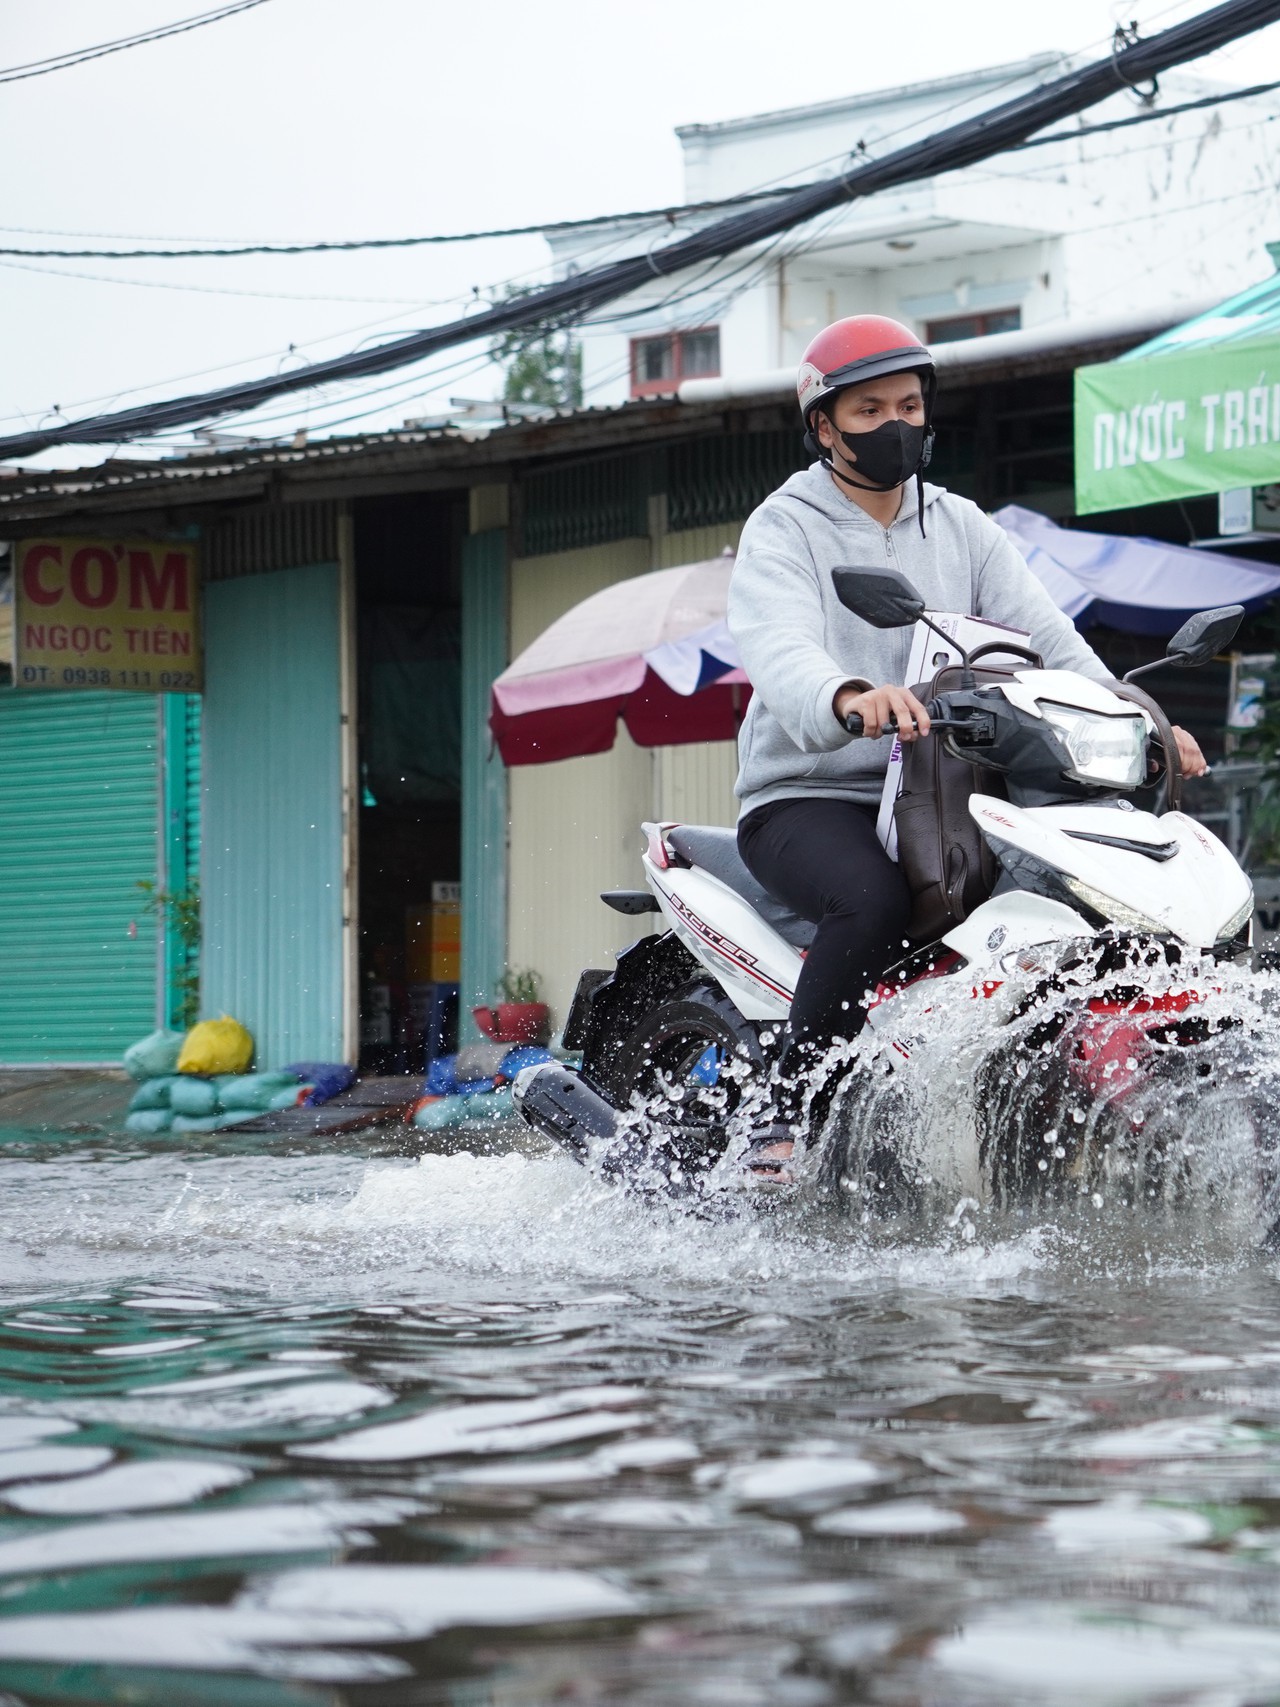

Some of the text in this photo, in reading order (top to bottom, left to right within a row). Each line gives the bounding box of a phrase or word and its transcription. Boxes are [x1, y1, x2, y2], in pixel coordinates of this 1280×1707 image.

[1094, 391, 1186, 472] NƯỚC
[22, 543, 190, 613] CƠM
[25, 624, 112, 657] NGỌC
[63, 667, 111, 686] 0938
[119, 669, 151, 686] 111
[160, 671, 195, 688] 022
[670, 893, 758, 967] EXCITER
